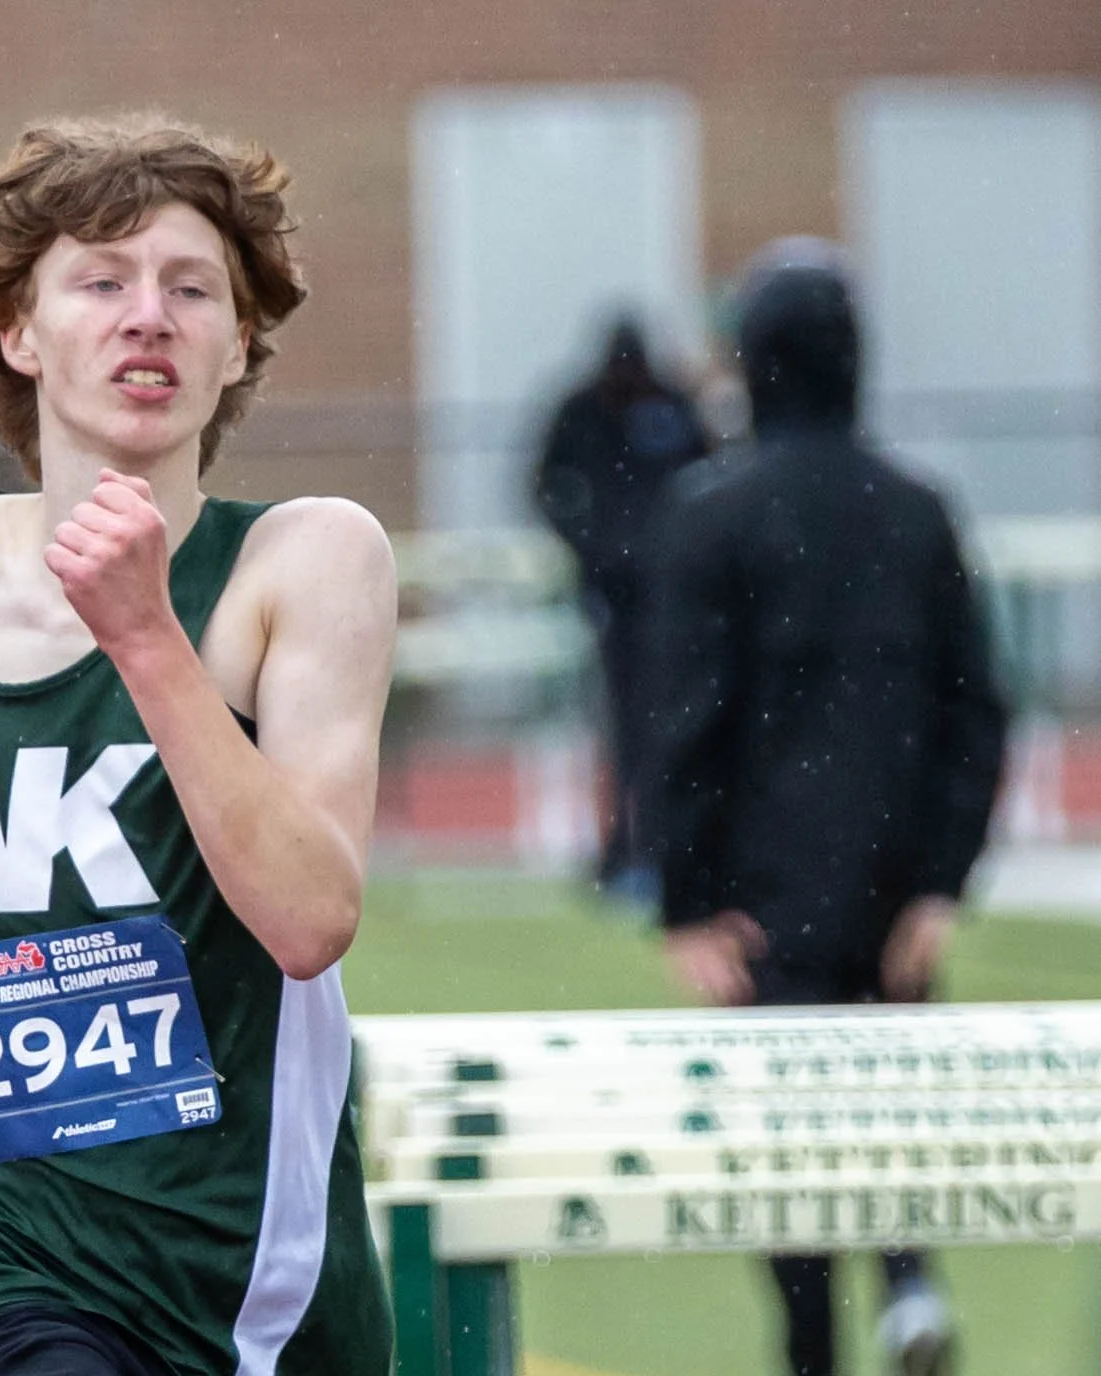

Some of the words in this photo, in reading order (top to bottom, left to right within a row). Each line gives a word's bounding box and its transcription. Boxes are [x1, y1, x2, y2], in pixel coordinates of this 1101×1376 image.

[49, 931, 116, 956] CROSS
[52, 943, 143, 972] COUNTRY
[0, 978, 60, 1004] REGIONAL
[59, 960, 159, 993] CHAMPIONSHIP
[180, 1107, 217, 1124] 2947
[664, 1182, 1077, 1237] KETTERING
